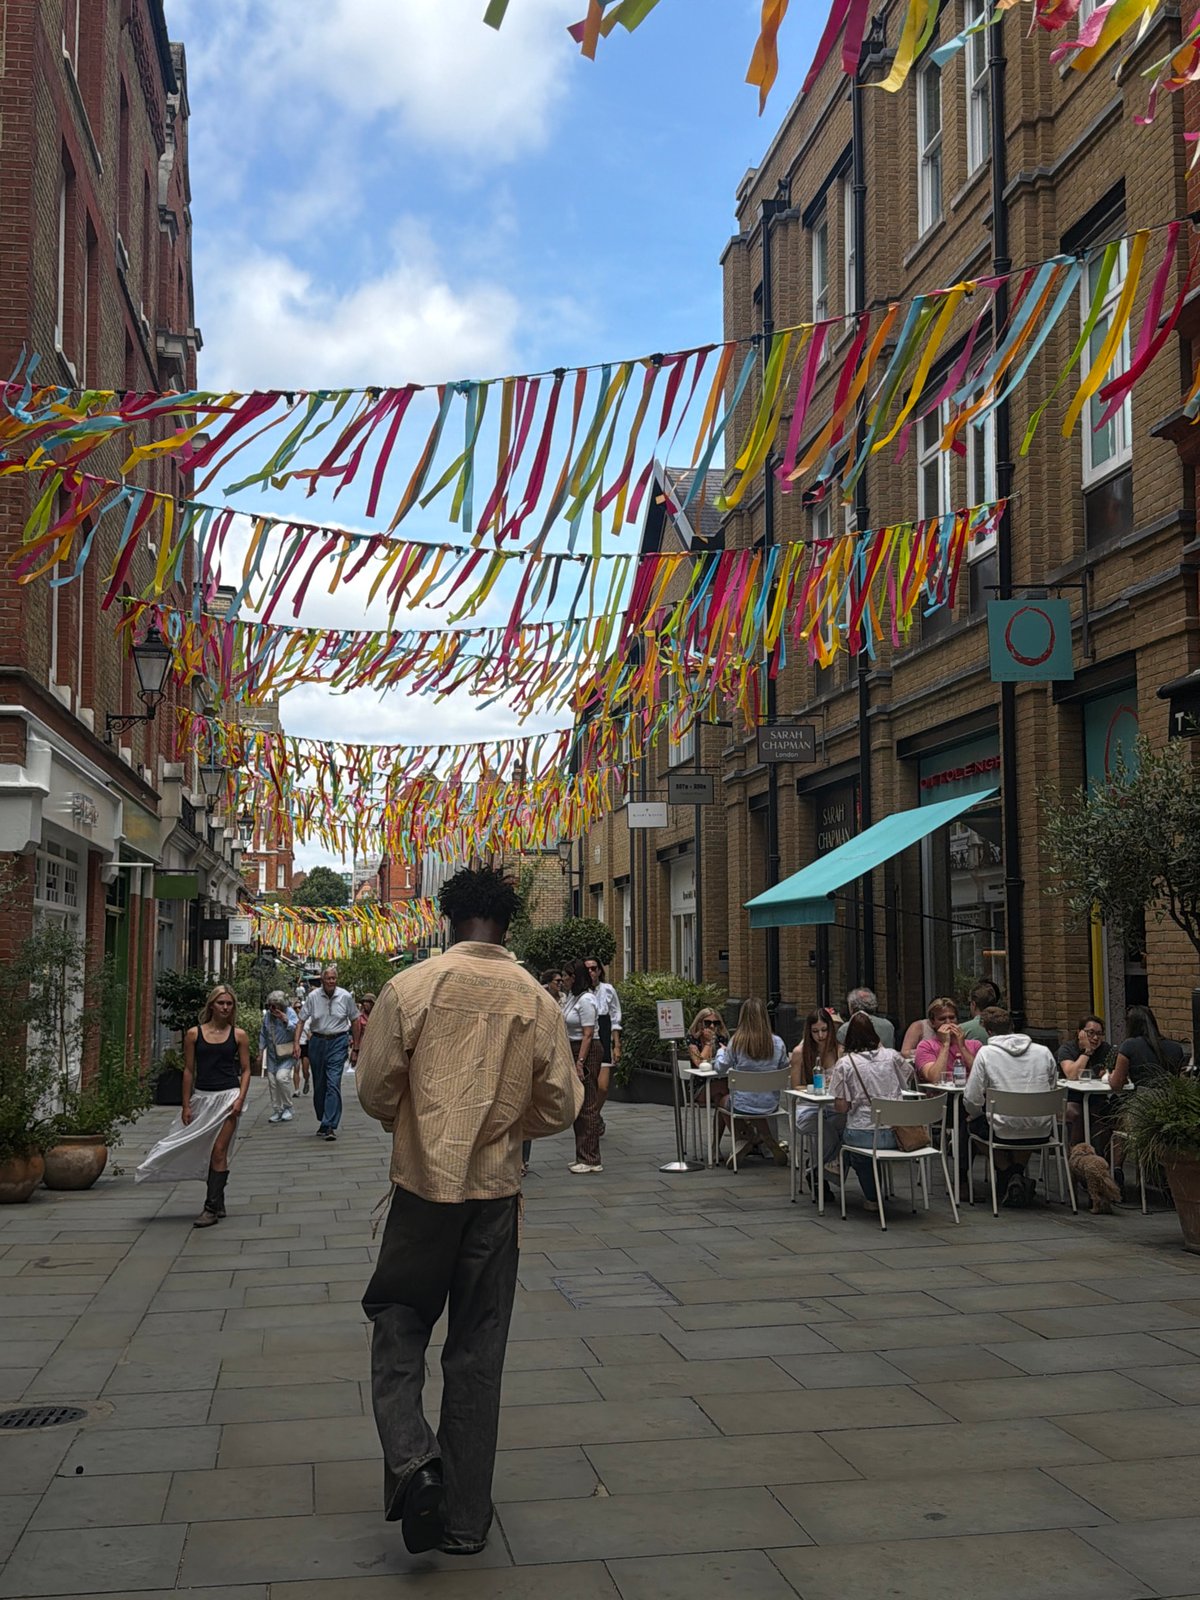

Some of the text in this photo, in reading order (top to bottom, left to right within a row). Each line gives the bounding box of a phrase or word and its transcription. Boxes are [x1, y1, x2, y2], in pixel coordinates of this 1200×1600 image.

[770, 730, 803, 740] SARAH
[761, 740, 811, 750] CHAPMAN
[823, 804, 845, 826] SARAH
